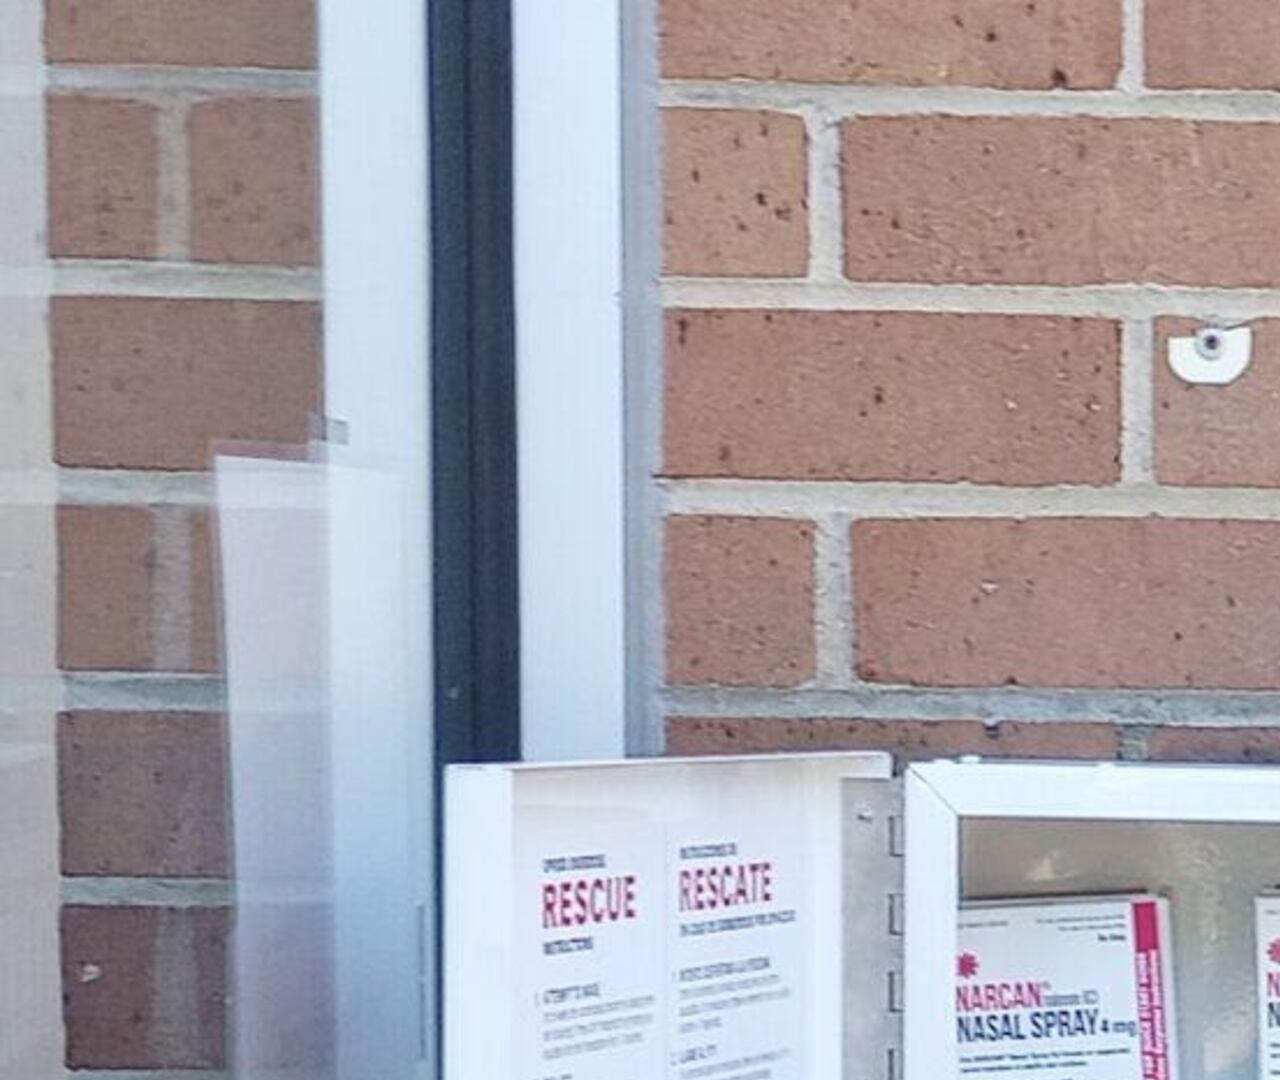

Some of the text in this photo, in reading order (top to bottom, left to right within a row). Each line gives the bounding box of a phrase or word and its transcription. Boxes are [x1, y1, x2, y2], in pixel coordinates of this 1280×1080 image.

[543, 876, 635, 928] RESCUE
[679, 863, 771, 911] RESCATE
[957, 1013, 1026, 1043] NASAL
[1031, 1008, 1098, 1038] SPRAY
